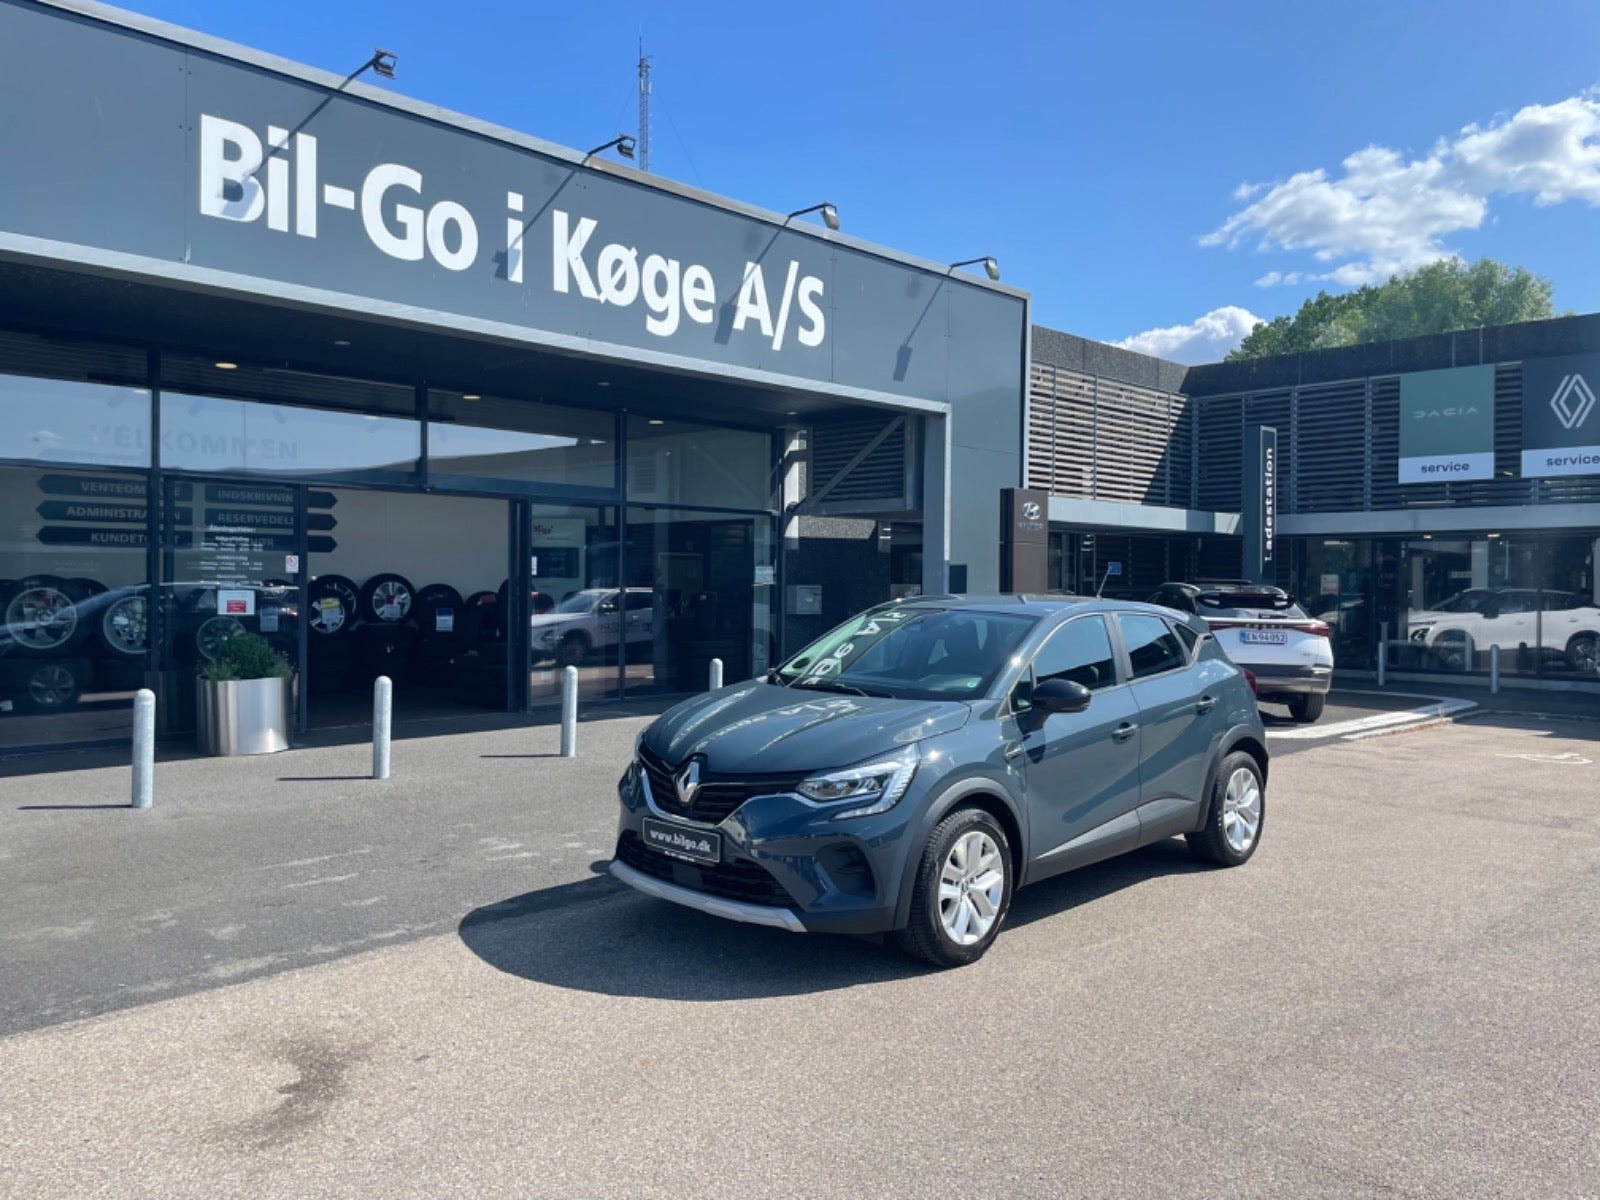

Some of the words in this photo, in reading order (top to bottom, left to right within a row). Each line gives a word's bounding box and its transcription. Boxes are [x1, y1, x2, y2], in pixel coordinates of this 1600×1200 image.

[200, 114, 479, 270] Bil-Go
[508, 192, 523, 283] i
[553, 210, 716, 337] Køge
[733, 261, 825, 351] A/S
[1412, 406, 1479, 419] DACIA
[1420, 461, 1470, 474] service
[1546, 454, 1600, 467] service
[1264, 447, 1273, 562] Ladestation
[650, 830, 711, 853] www.bilgo.dk
